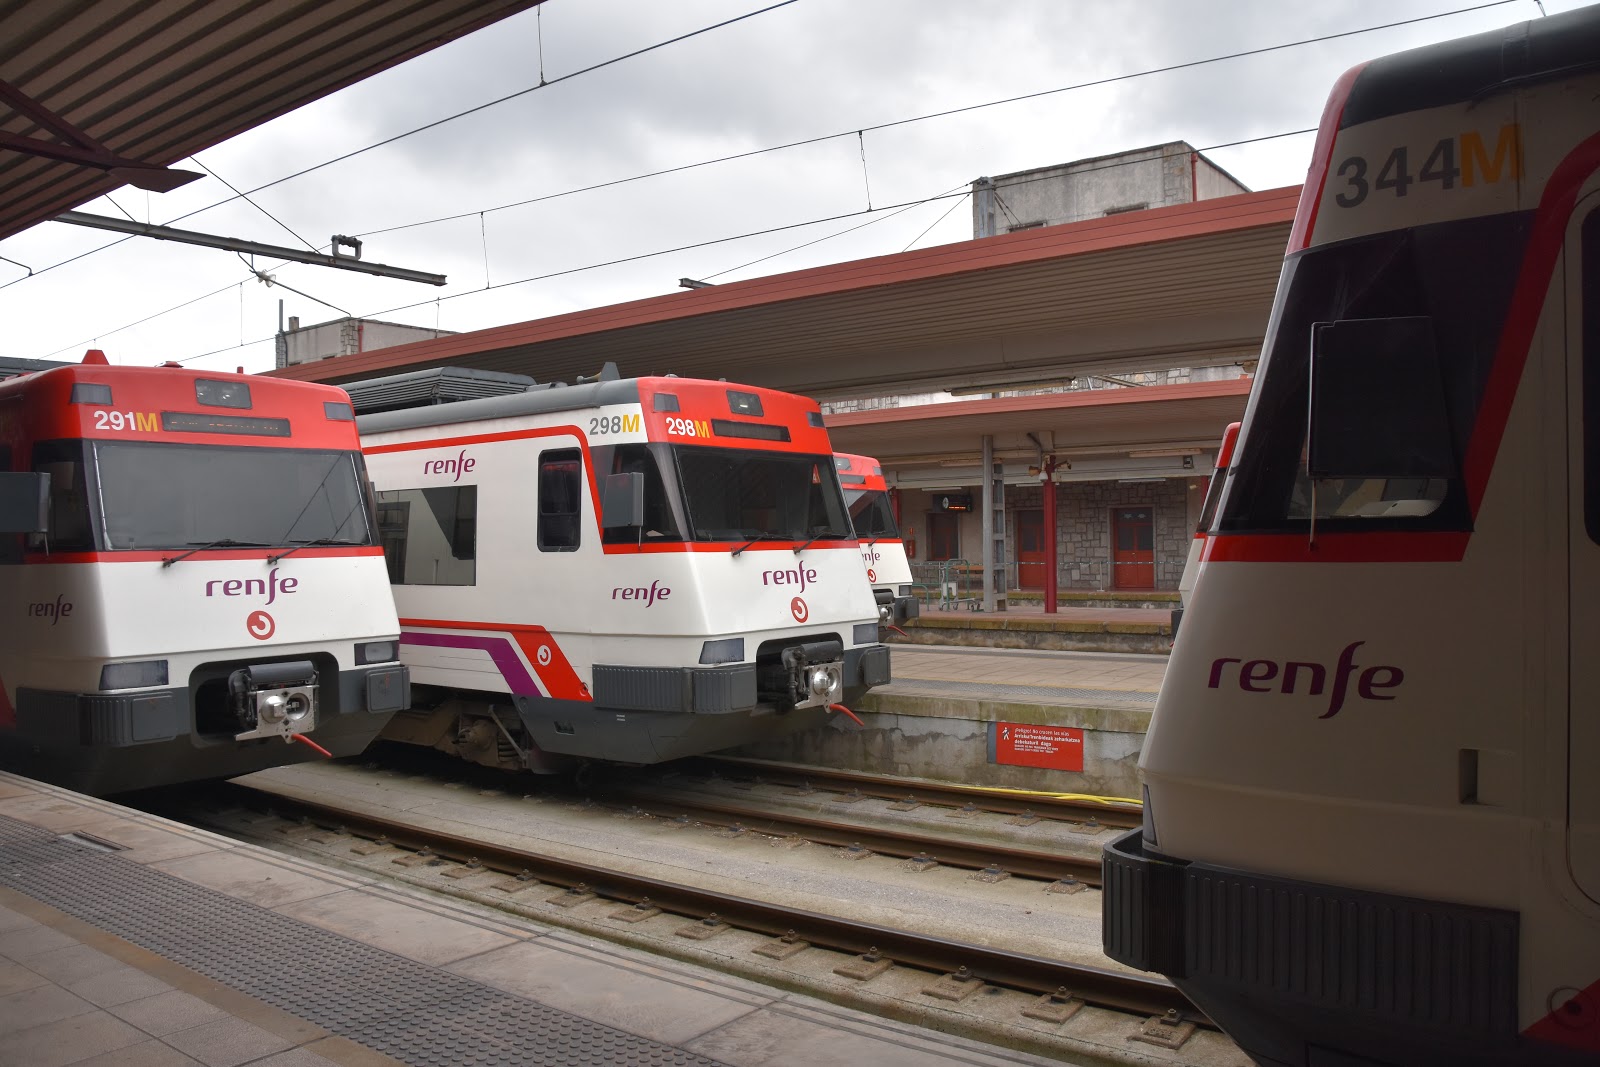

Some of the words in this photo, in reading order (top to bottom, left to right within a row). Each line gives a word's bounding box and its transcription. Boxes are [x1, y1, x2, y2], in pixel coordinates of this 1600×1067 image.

[1335, 122, 1523, 209] 344M
[94, 410, 158, 432] 291M
[589, 414, 640, 436] 298M
[665, 416, 711, 439] 298M
[424, 449, 476, 483] renfe
[206, 567, 298, 606] renfe
[762, 560, 817, 593] renfe
[28, 593, 73, 626] renfe
[612, 579, 671, 608] renfe
[1208, 640, 1405, 719] renfe
